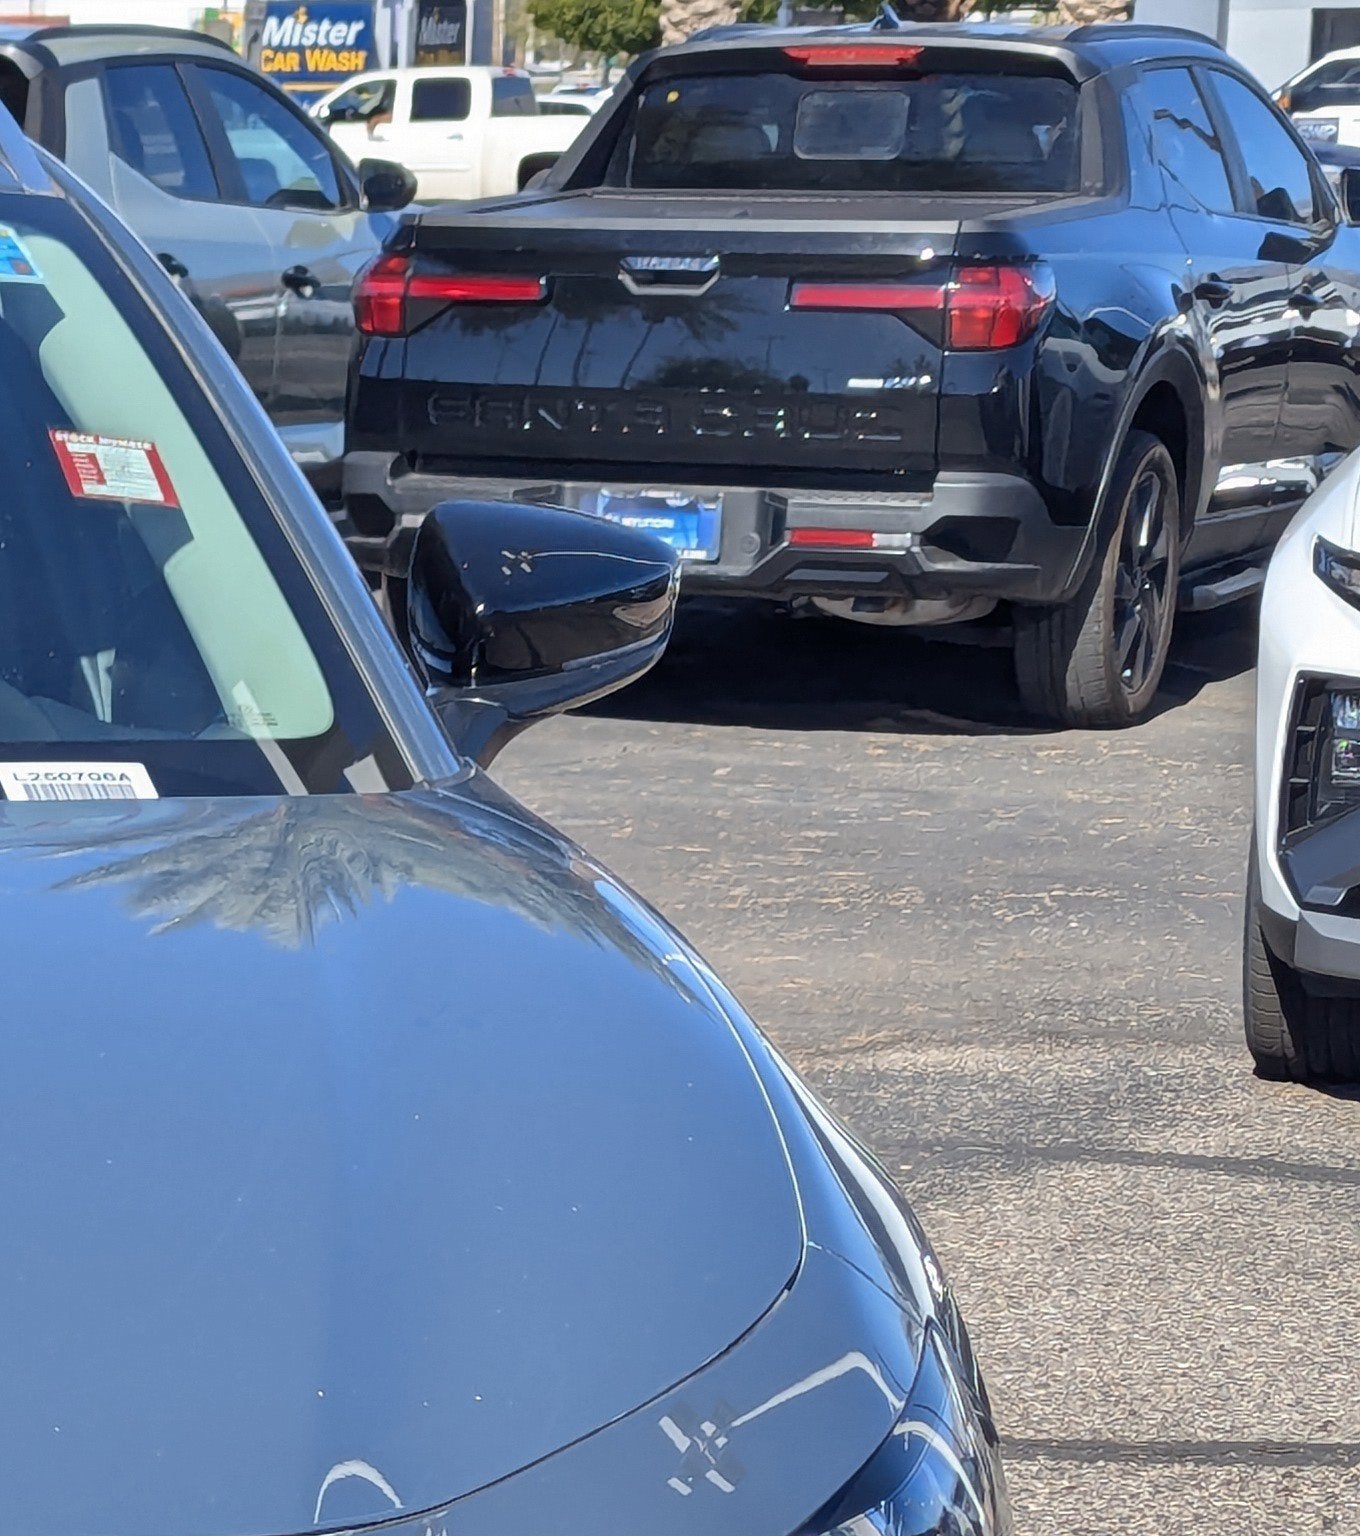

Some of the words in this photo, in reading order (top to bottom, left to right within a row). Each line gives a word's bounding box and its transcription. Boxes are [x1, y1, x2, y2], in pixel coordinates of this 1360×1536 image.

[262, 16, 365, 46] Mister
[261, 49, 300, 72] CAR
[305, 49, 366, 72] WASH
